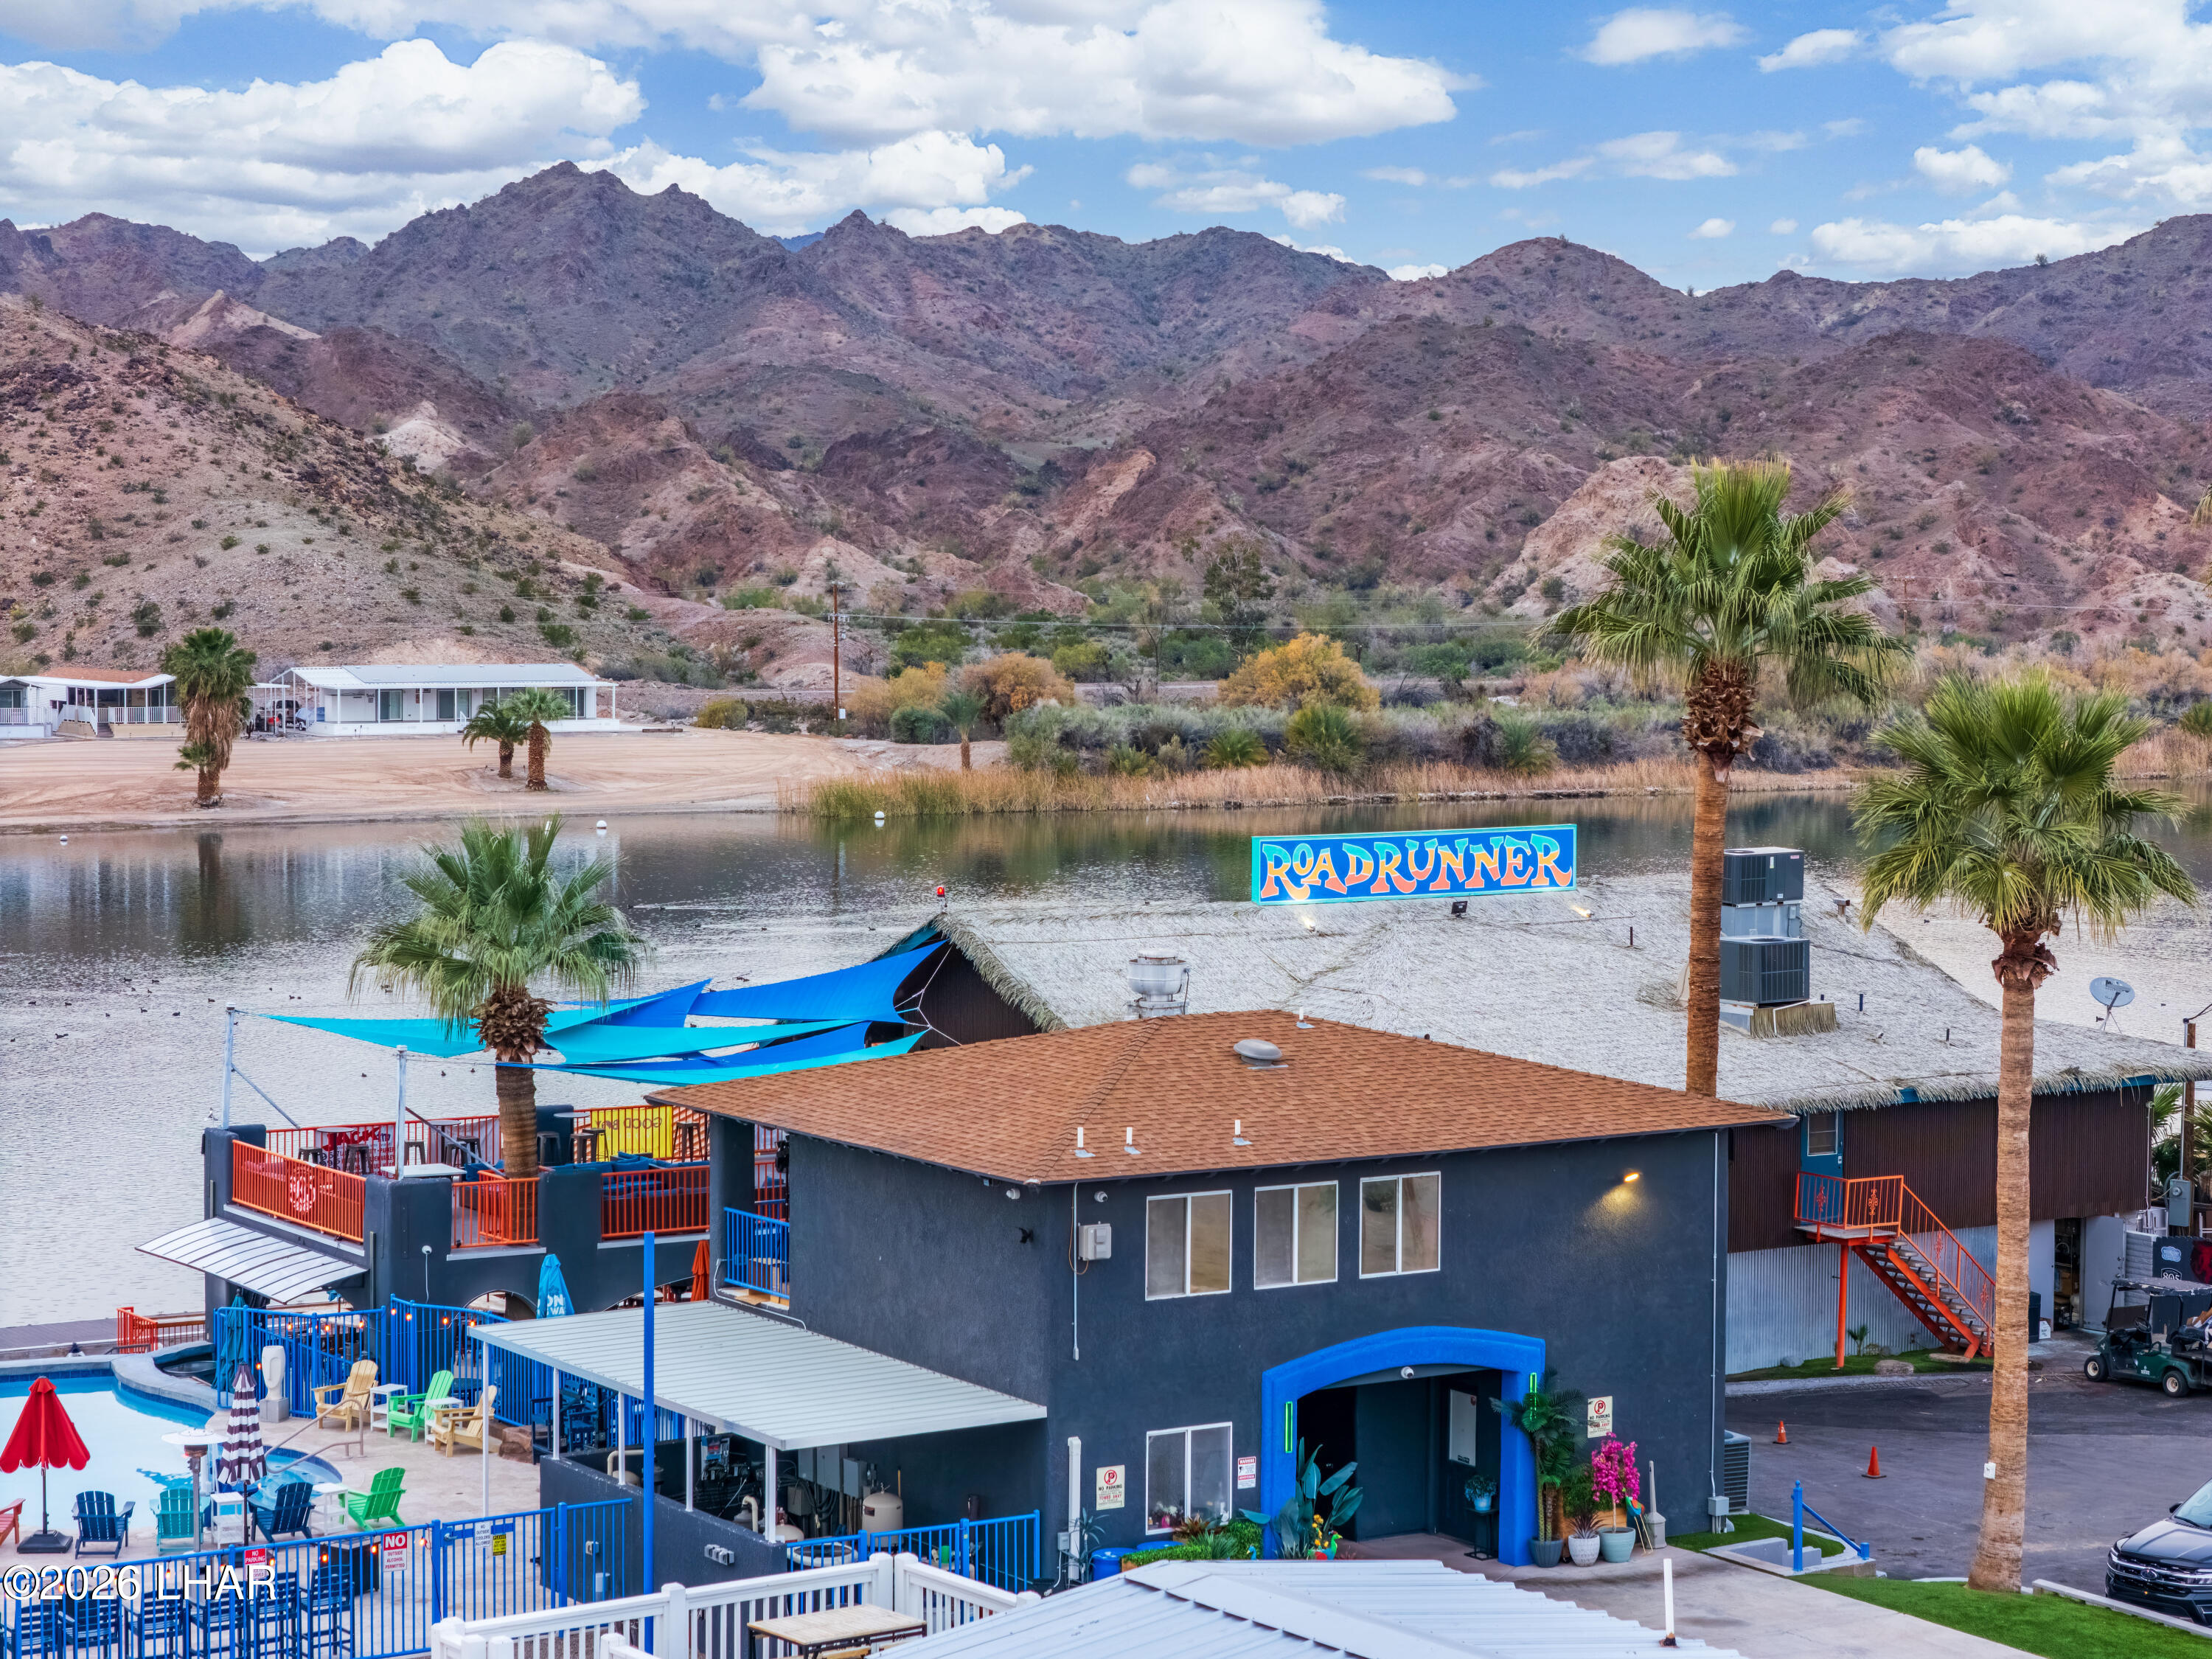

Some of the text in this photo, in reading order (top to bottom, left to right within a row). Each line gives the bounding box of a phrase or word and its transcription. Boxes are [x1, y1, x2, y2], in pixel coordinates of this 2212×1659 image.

[1260, 834, 1572, 900] ROADRUNNER
[2163, 1272, 2180, 1281] 805
[385, 1534, 406, 1548] NO
